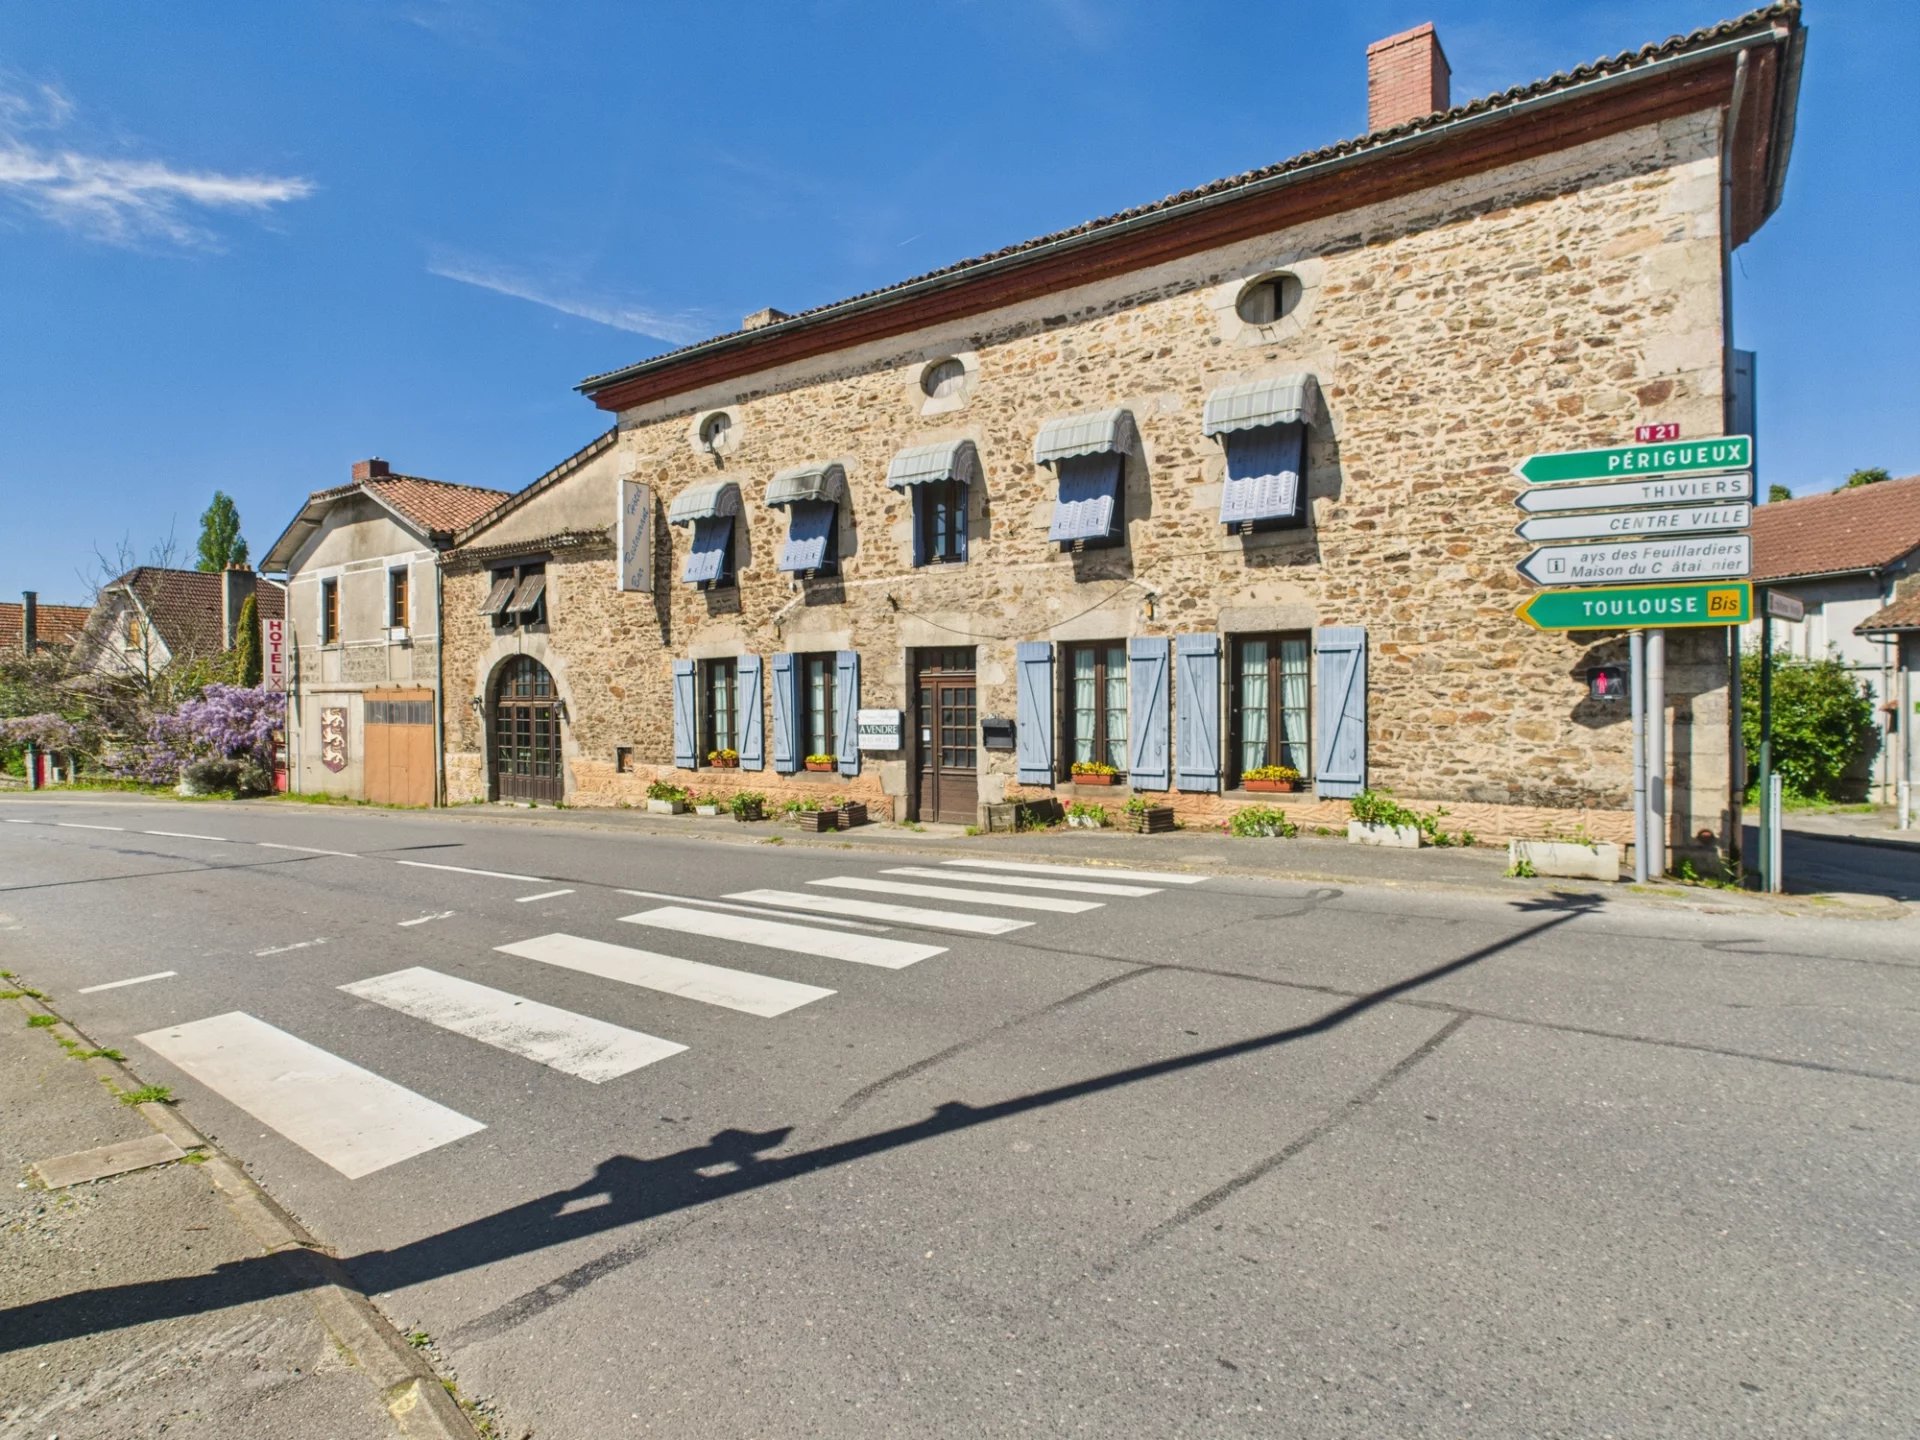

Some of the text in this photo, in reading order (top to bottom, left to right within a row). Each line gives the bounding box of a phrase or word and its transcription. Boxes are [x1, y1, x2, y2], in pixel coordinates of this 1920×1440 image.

[1639, 425, 1676, 440] N 21
[1608, 444, 1741, 471] PÉRIGUEUX
[1642, 480, 1741, 498] THIVIERS
[1609, 510, 1743, 531] CENTRE VILLE
[1580, 543, 1742, 564] ays des Feuillardiers
[1571, 559, 1743, 578] Maison du Câtainier
[1583, 595, 1738, 616] TOULOUSE Bis
[269, 621, 282, 674] HOTEL
[866, 725, 897, 734] VENDRE
